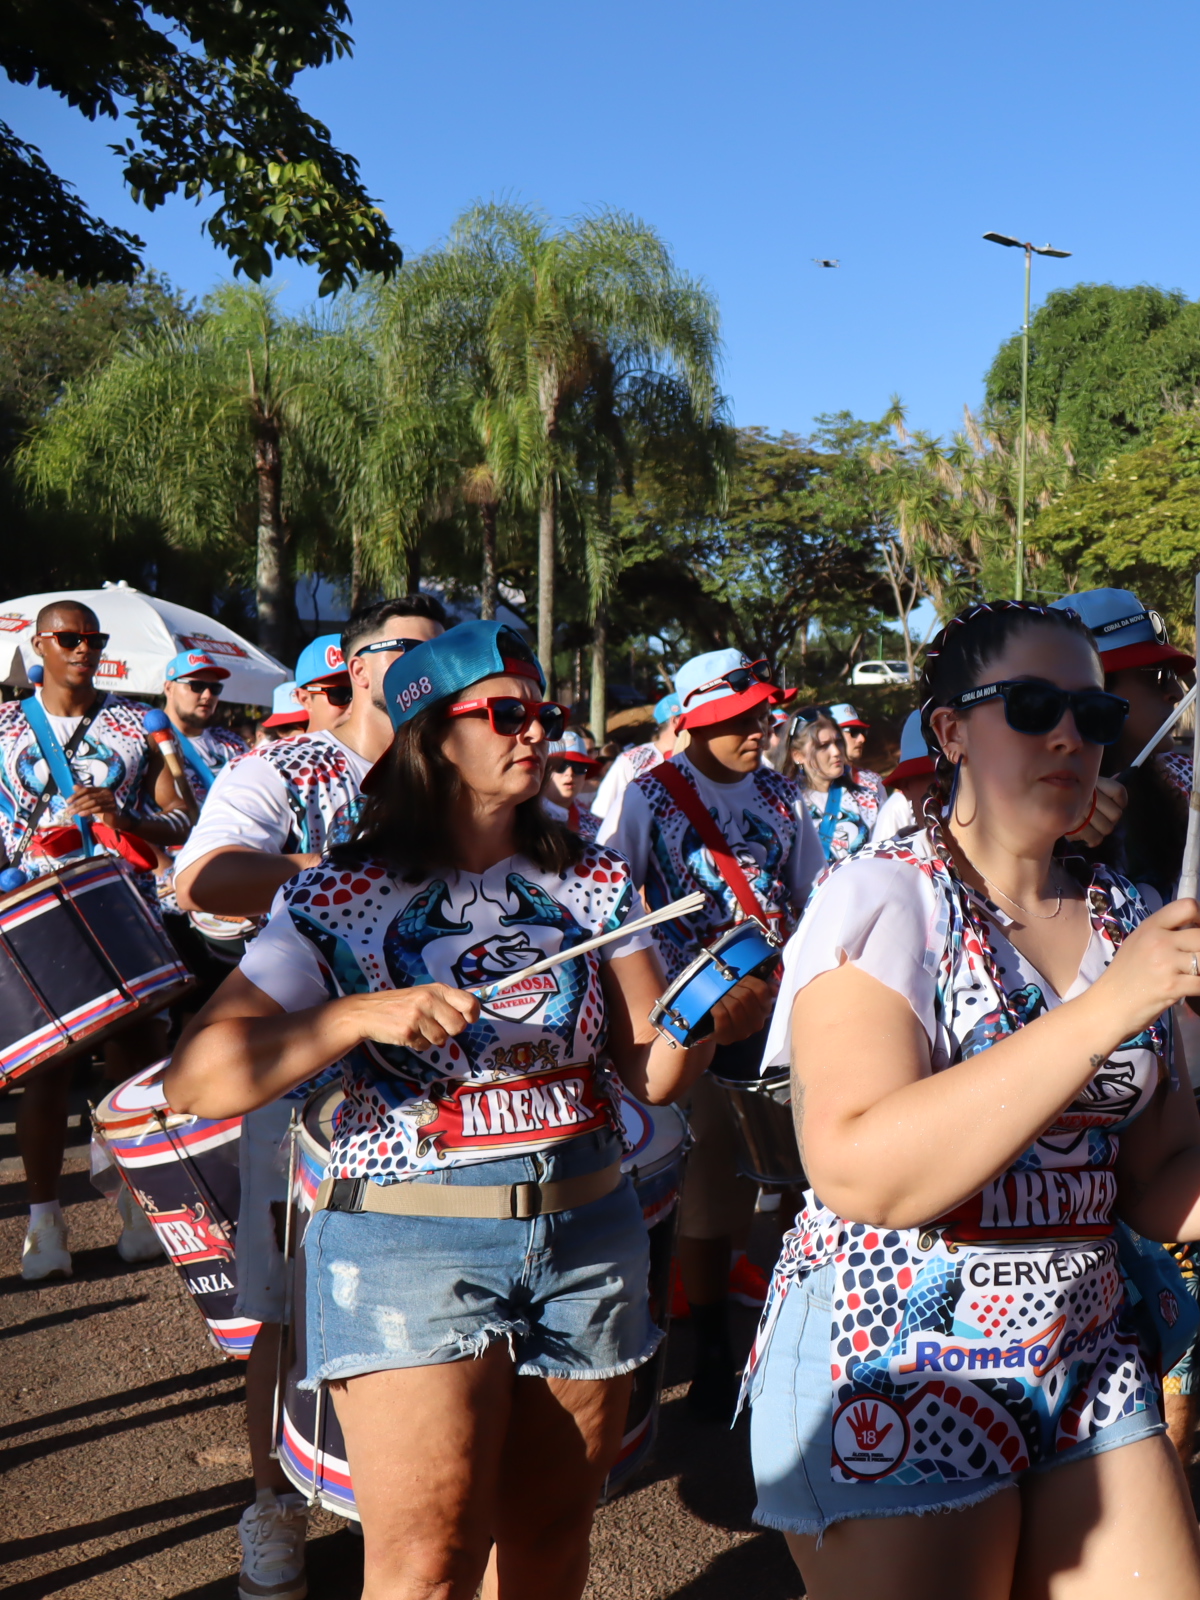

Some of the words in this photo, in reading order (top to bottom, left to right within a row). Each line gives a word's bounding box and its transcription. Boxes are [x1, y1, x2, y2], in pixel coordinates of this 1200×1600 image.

[1104, 622, 1121, 633] CORAL
[1121, 618, 1130, 627] DA
[1130, 614, 1145, 623] NOVA
[396, 676, 432, 712] 1988
[962, 691, 976, 702] CORAL
[976, 689, 983, 698] DA
[983, 684, 997, 695] NOVA
[492, 996, 537, 1010] BATERIA
[459, 1078, 595, 1137] KREMER
[979, 1170, 1118, 1228] KREMER
[915, 1338, 1049, 1373] Romão
